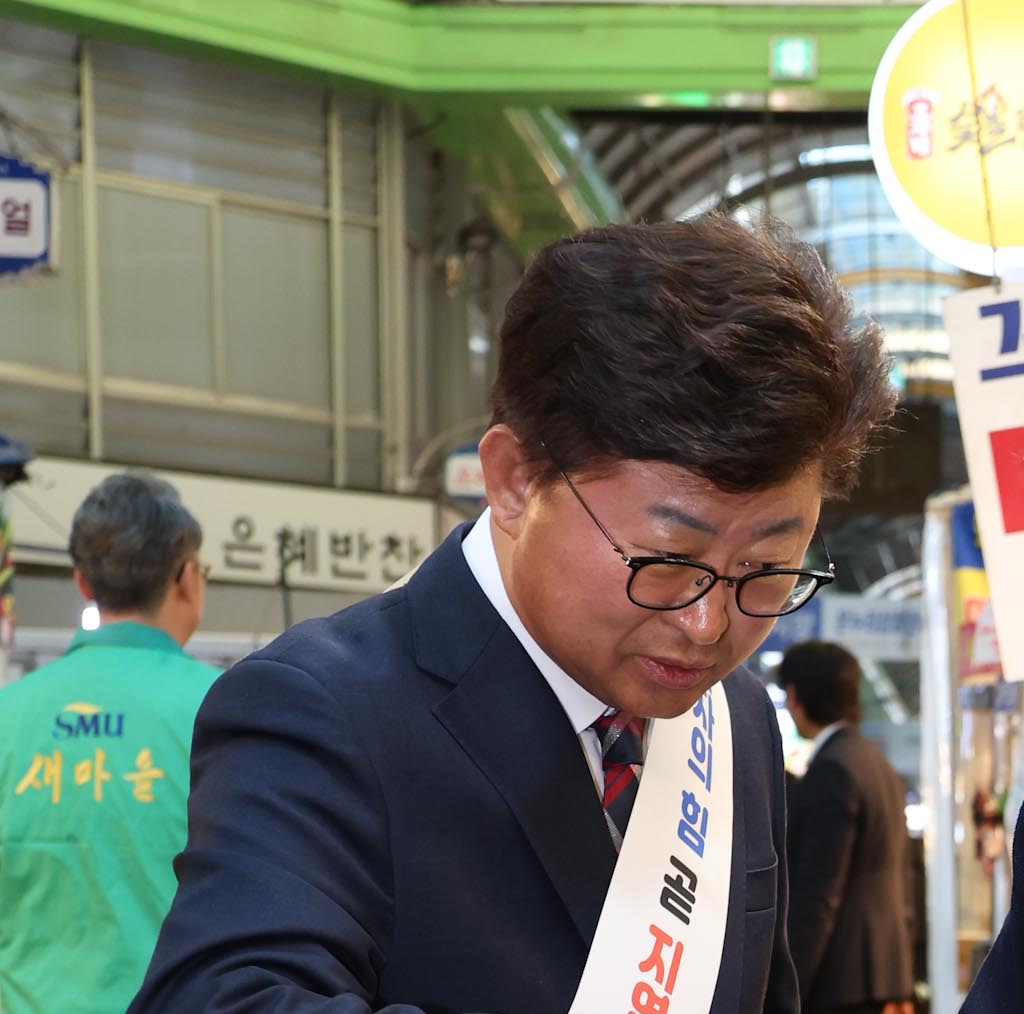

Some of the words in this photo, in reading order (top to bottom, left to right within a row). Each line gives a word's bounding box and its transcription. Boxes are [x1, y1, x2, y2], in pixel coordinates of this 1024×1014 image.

[52, 712, 125, 739] SMU
[15, 748, 165, 804] 새마을
[677, 790, 709, 858] 힘
